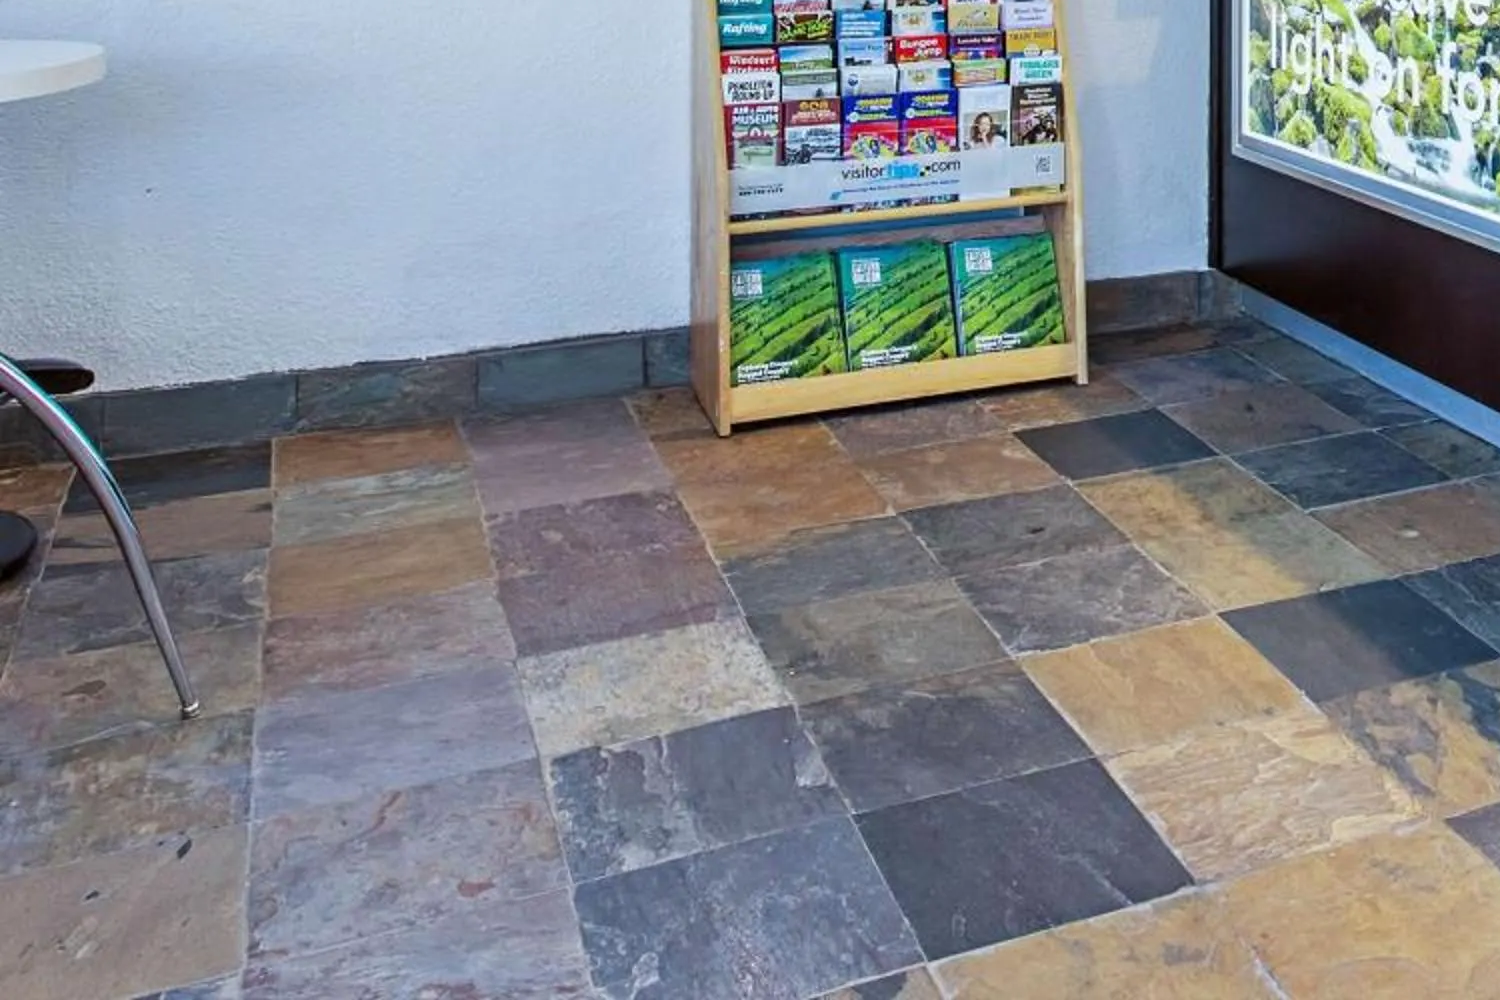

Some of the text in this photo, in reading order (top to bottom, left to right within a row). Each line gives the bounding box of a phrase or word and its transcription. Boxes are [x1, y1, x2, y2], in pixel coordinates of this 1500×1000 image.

[723, 21, 768, 35] Rafting
[899, 39, 938, 50] Bungee
[1269, 1, 1356, 95] light
[1370, 51, 1420, 107] on
[727, 80, 773, 94] PENDLETON
[731, 114, 779, 125] MUSEUM
